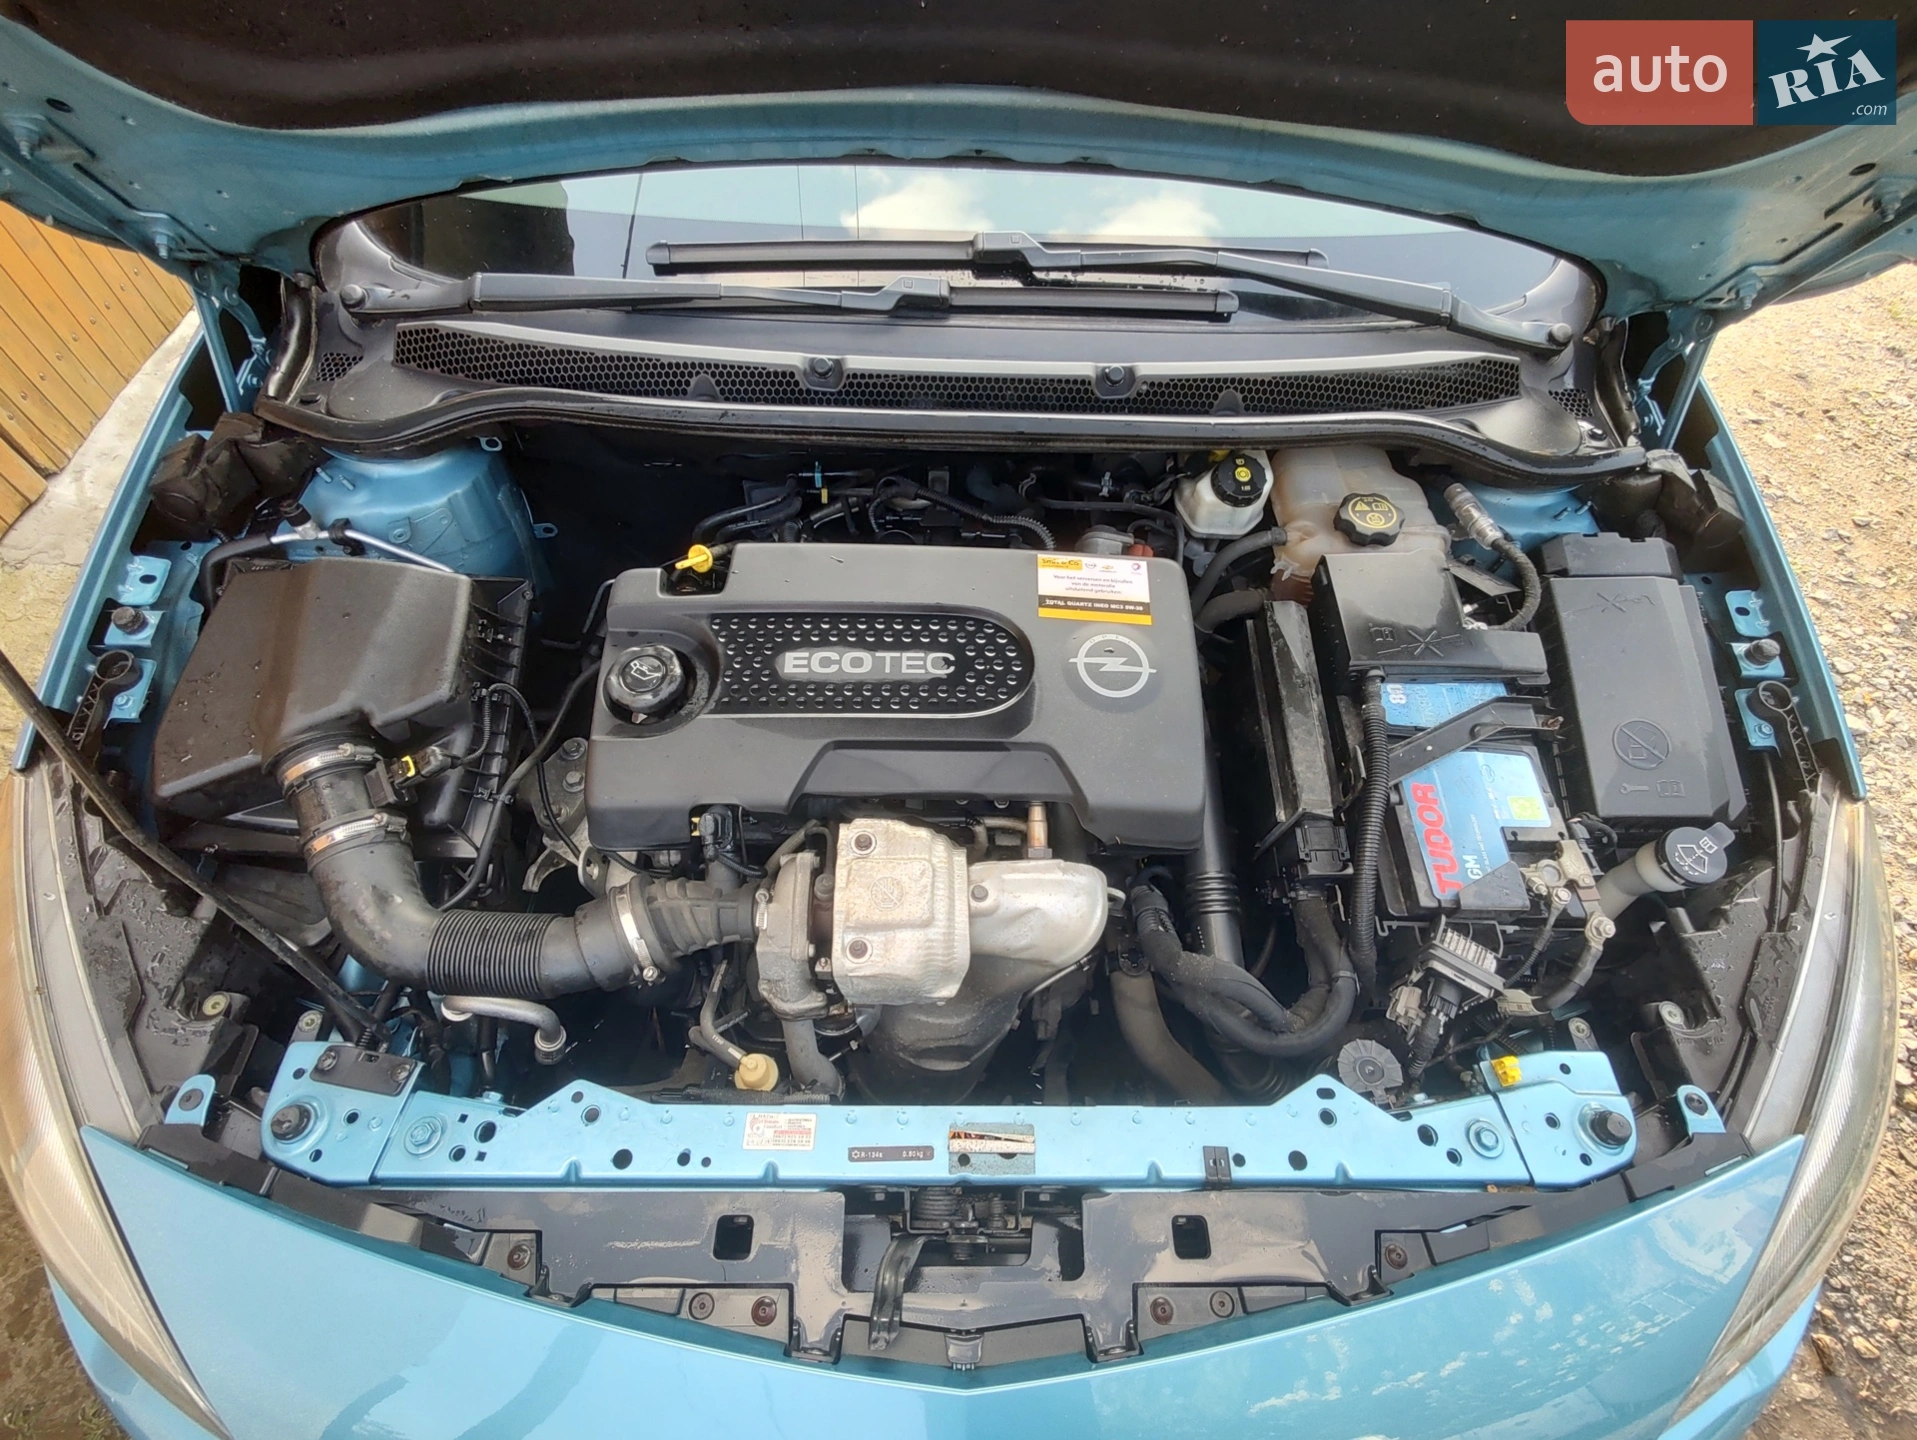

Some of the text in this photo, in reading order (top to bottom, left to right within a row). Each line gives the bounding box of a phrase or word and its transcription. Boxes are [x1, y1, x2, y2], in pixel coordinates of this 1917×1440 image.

[1045, 598, 1066, 606] TOTAL
[784, 651, 956, 675] ECOTEC
[1410, 782, 1465, 895] TUDOR
